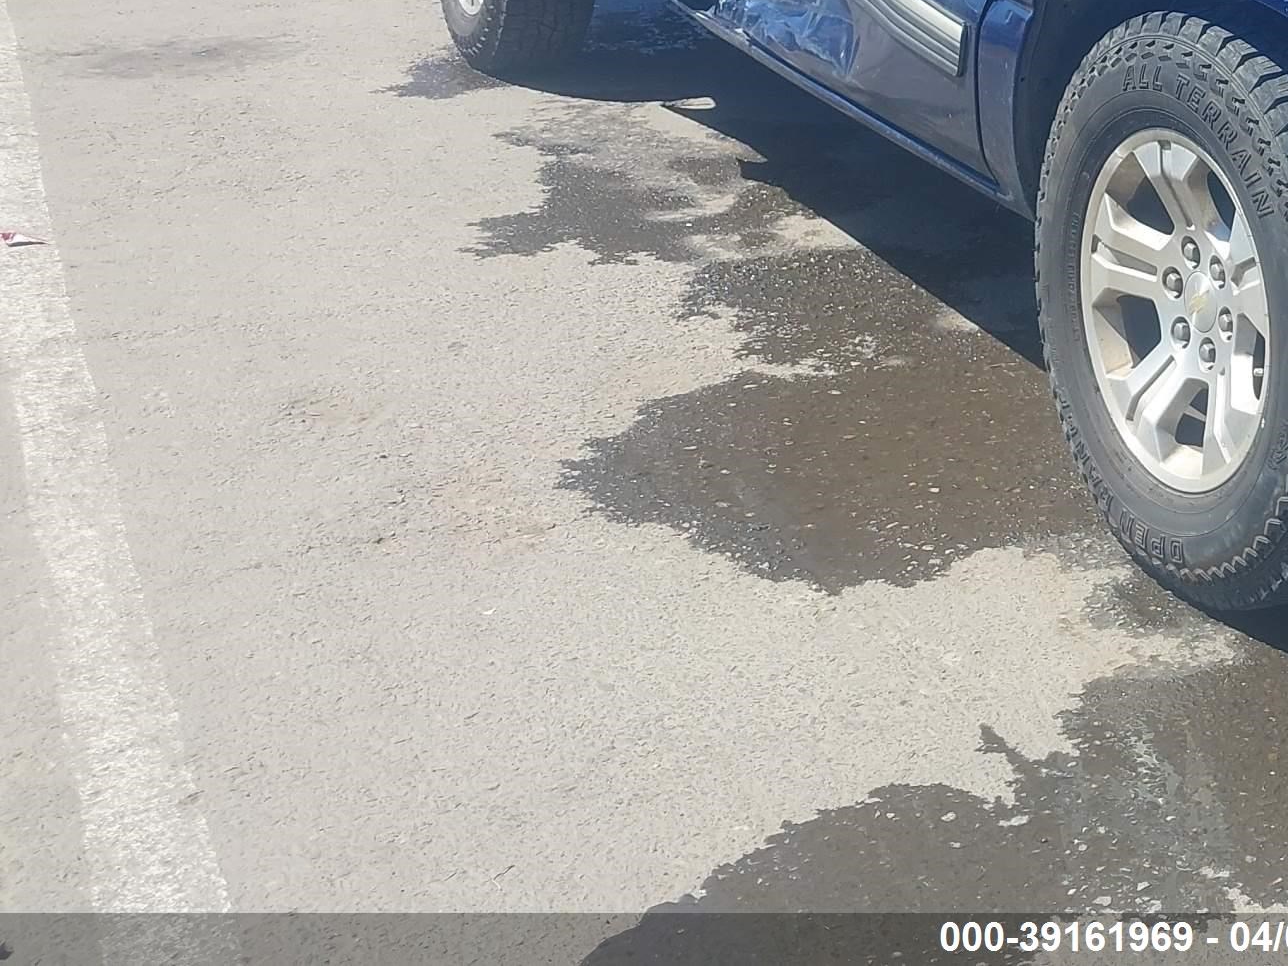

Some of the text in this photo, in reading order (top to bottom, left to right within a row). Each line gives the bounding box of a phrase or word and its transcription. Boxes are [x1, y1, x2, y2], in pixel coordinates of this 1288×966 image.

[1122, 63, 1275, 219] ALL TERRAIN
[1118, 508, 1184, 564] OPEN
